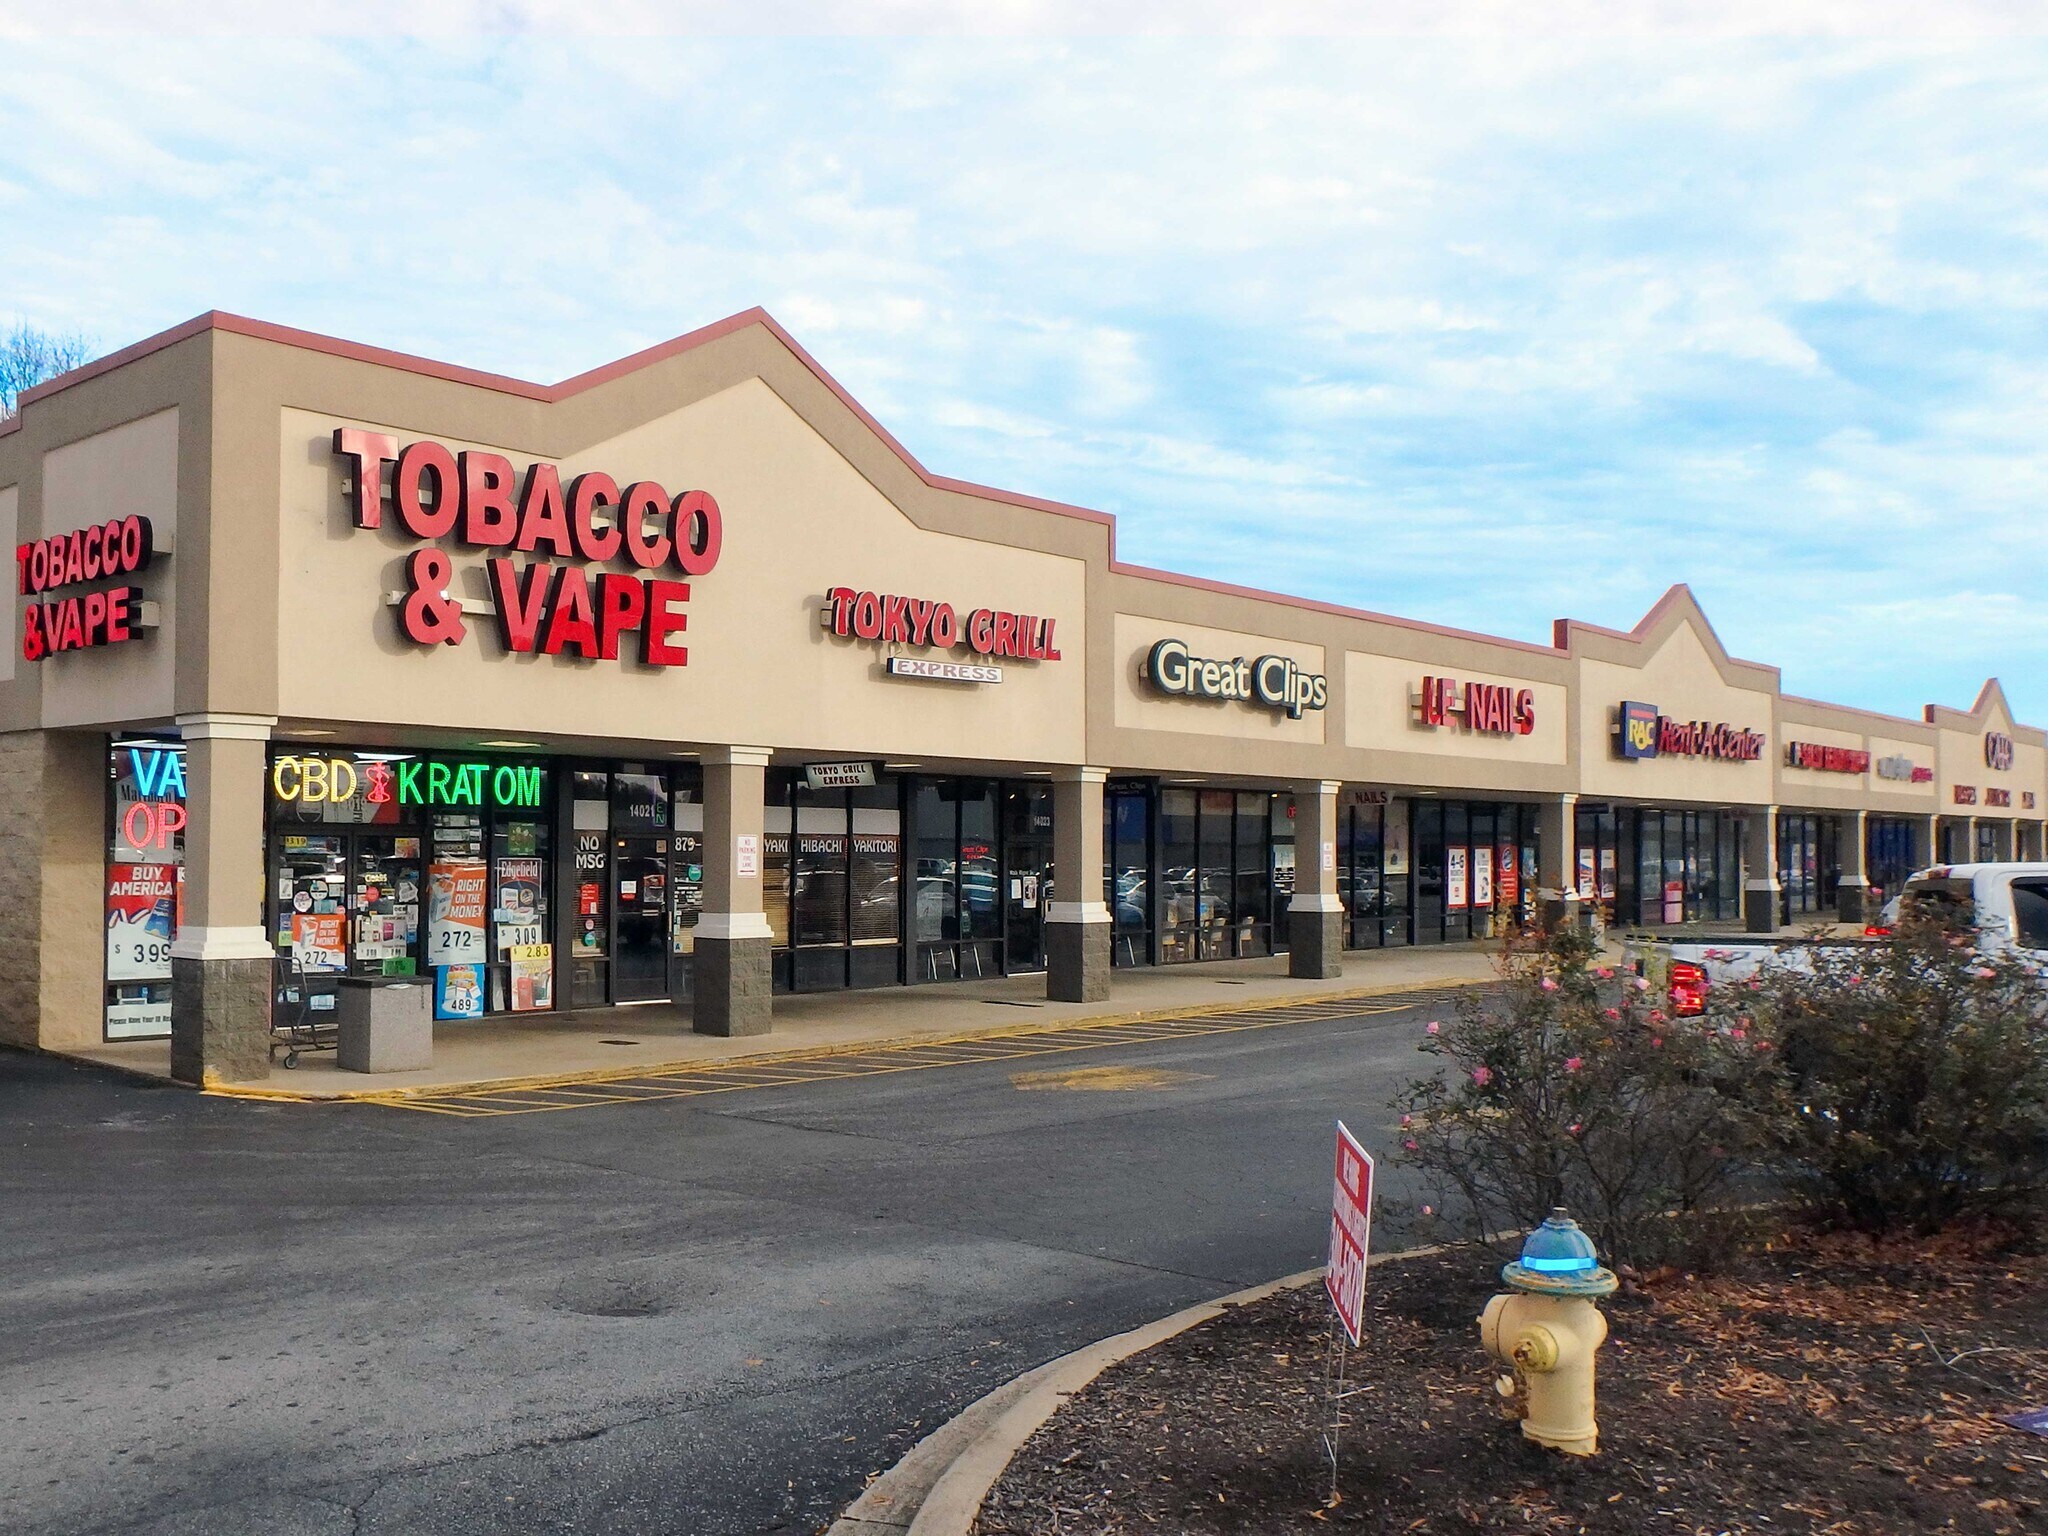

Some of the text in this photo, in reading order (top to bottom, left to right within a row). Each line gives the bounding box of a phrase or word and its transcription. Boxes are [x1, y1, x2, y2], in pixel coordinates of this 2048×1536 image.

[333, 427, 722, 576] TOBACCO
[17, 514, 150, 595] TOBACCO
[403, 548, 691, 667] & VAPE
[24, 587, 140, 661] & VAPE
[830, 587, 1062, 661] TOKYO GRILL
[896, 659, 998, 681] EXPRESS
[1155, 642, 1327, 718] Great Clips
[1423, 676, 1534, 735] LE NAILS
[1629, 719, 1654, 751] RAC
[131, 749, 186, 797] VA
[274, 756, 357, 802] CBD
[813, 764, 866, 775] TOKYO GRILL
[823, 775, 860, 785] EXPRESS
[1355, 791, 1387, 804] NAILS
[630, 804, 655, 817] 14021
[124, 802, 187, 849] OP
[580, 836, 600, 851] NO
[764, 839, 897, 853] YAKI HIBACHI YAKITORI
[501, 861, 538, 879] Edgefield
[576, 854, 604, 869] MSG
[132, 867, 163, 880] BUY
[457, 879, 485, 892] RIGHT
[455, 893, 480, 904] ON THE
[450, 905, 485, 918] MONEY
